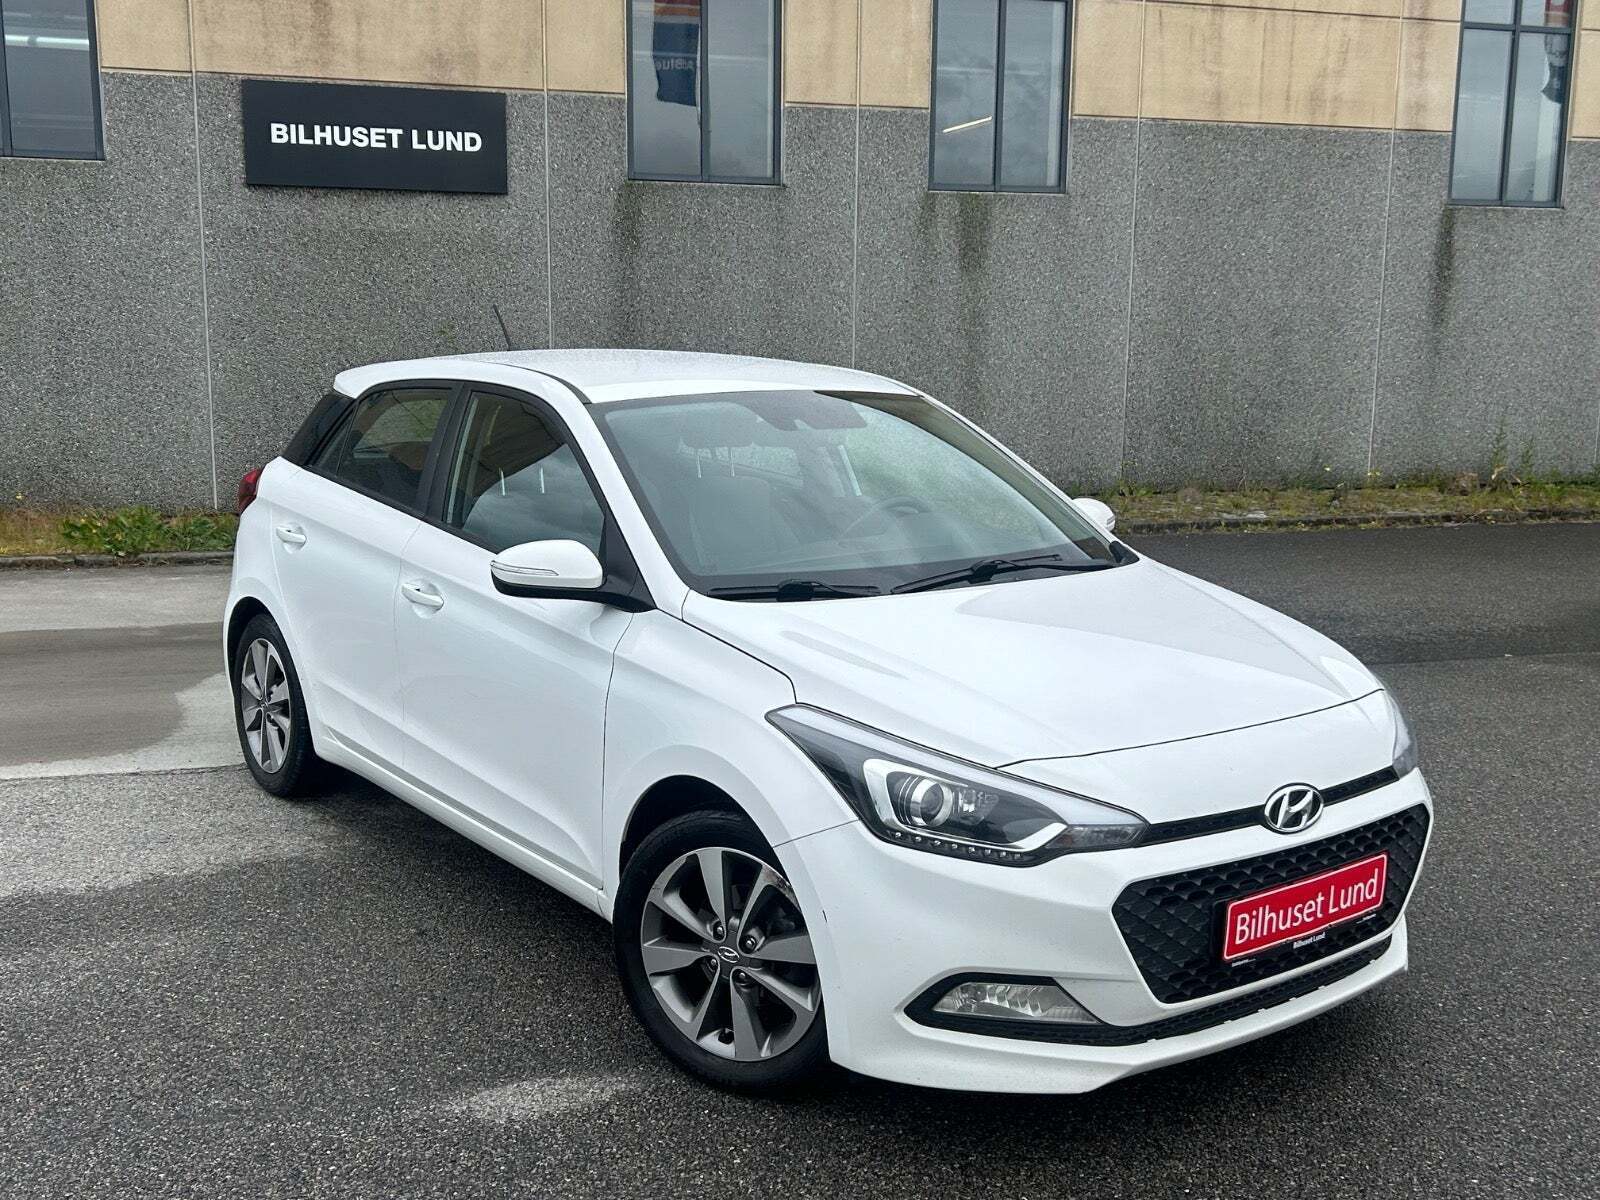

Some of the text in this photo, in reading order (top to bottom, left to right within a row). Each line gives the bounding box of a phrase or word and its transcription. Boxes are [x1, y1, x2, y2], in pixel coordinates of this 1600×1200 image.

[270, 123, 483, 152] BILHUSET LUND
[1235, 867, 1379, 945] Bilhuset Lund
